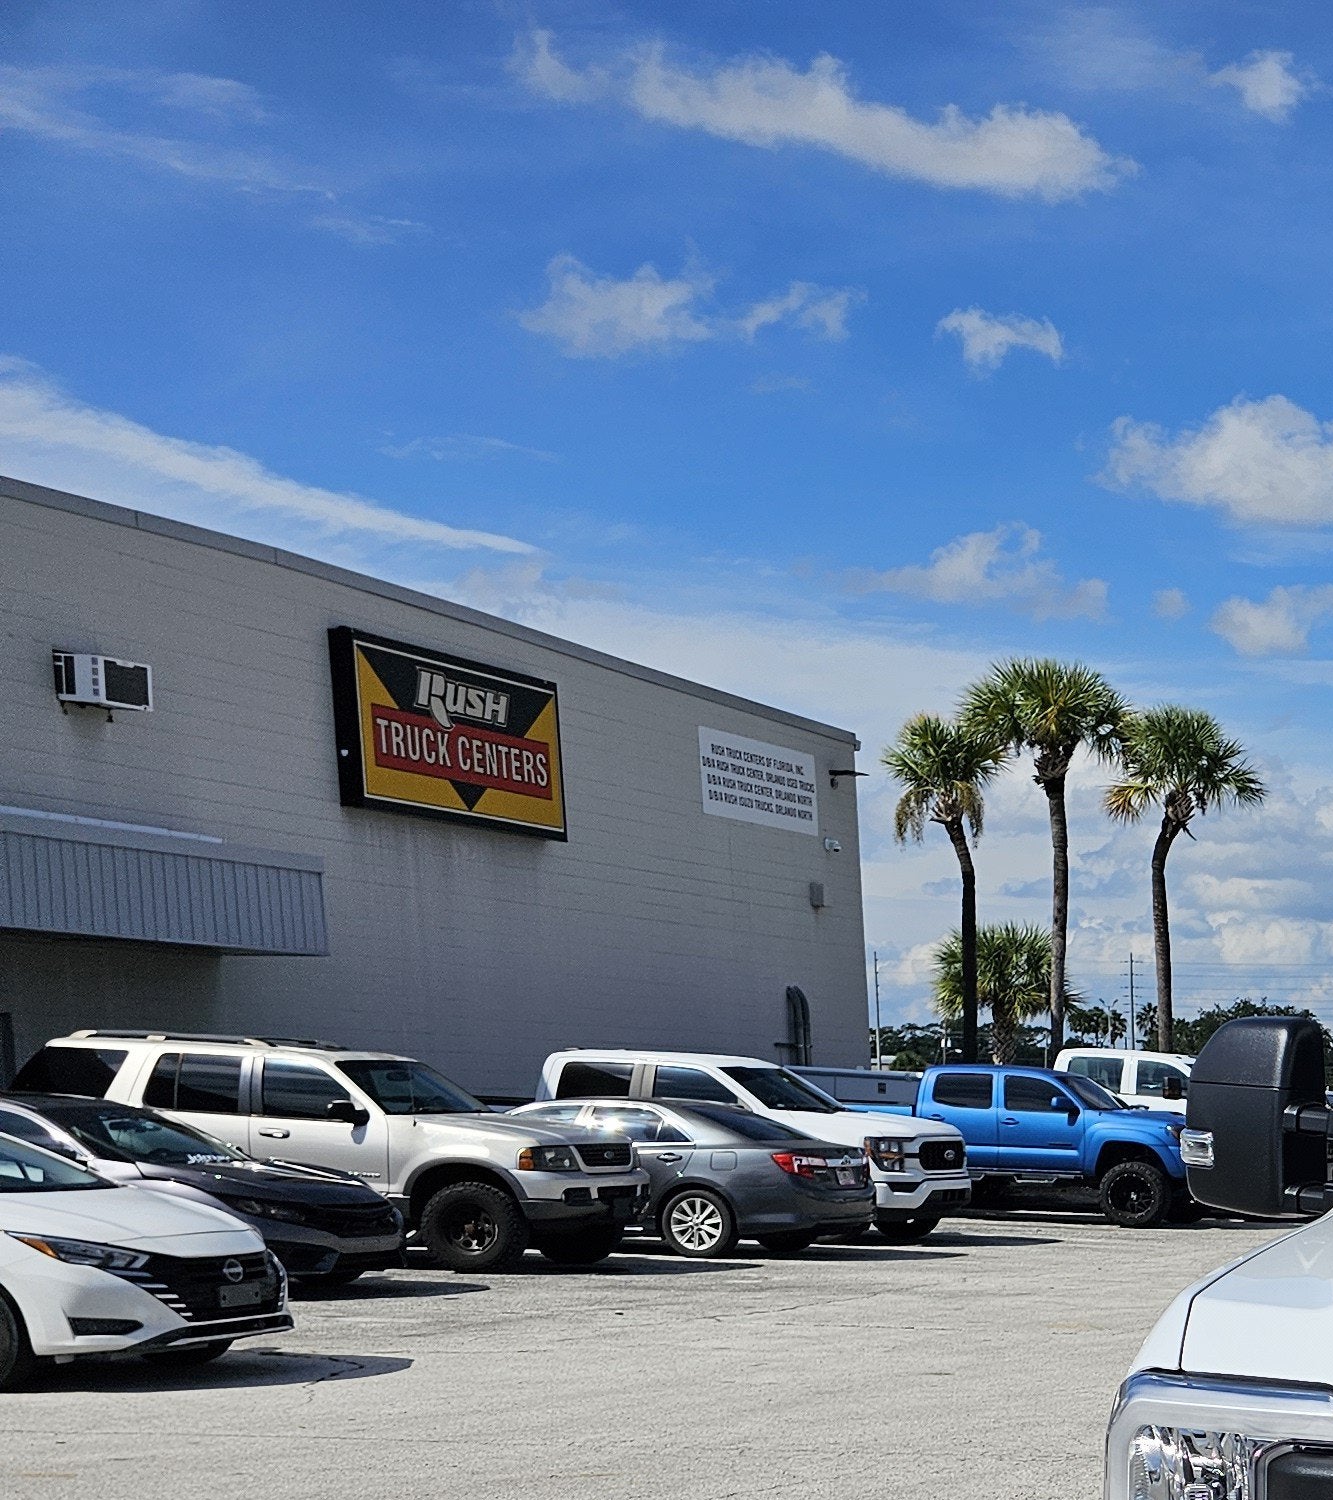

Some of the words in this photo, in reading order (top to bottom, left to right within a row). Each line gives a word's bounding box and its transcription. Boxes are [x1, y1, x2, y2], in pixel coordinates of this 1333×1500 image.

[414, 666, 511, 731] RUSH
[376, 718, 451, 767] TRUCK
[457, 736, 548, 787] CENTERS
[711, 743, 725, 756] RUSH
[726, 747, 742, 760] TRUCK
[743, 751, 765, 767] CENTERS
[766, 757, 772, 768] OF
[716, 760, 729, 772] RUSH
[730, 763, 745, 776] TRUCK
[766, 772, 786, 787] ORLANDO
[787, 777, 798, 789] USED
[799, 780, 815, 793] TRUCKS
[722, 777, 736, 789] RUSH
[737, 780, 753, 793] TRUCK
[775, 789, 796, 804] ORLANDO
[797, 795, 813, 807] NORTH
[724, 792, 737, 805] RUSH
[738, 796, 754, 809] ISUZU
[775, 804, 796, 818] ORLANDO
[797, 809, 813, 821] NORTH
